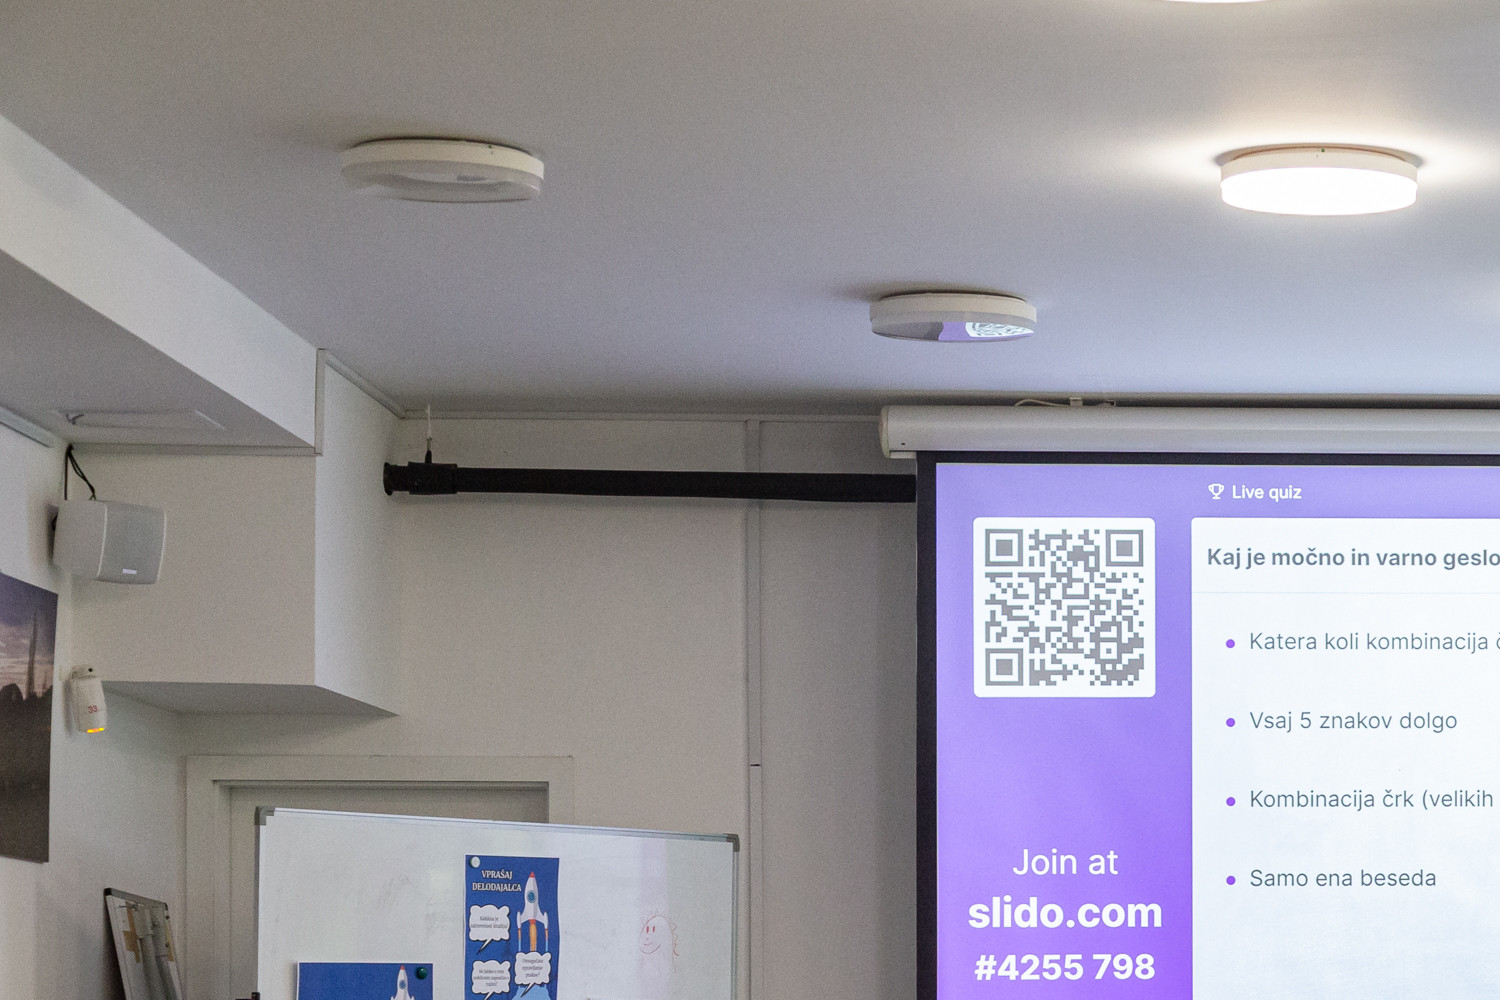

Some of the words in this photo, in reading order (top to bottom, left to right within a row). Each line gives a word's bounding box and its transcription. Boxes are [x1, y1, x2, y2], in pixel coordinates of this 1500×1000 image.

[1232, 484, 1265, 500] Live
[1268, 484, 1303, 503] quiz
[1207, 547, 1241, 570] Kaj
[1245, 547, 1266, 570] je
[1271, 546, 1345, 566] močno
[1351, 547, 1370, 566] in
[1376, 552, 1437, 566] varno
[1250, 632, 1317, 650] Katera
[1325, 631, 1359, 650] koli
[1366, 631, 1488, 655] kombinacija
[1249, 710, 1292, 734] Vsaj
[1300, 711, 1312, 729] 5
[1319, 711, 1393, 730] znakov
[1399, 711, 1458, 734] dolgo
[1250, 789, 1375, 812] Kombinacija
[1382, 788, 1415, 808] črk
[1421, 788, 1495, 811] (velikih
[1012, 848, 1077, 876] Join
[1088, 850, 1119, 875] at
[481, 869, 513, 880] VPRAŠAJ
[1250, 869, 1309, 887] Samo
[1315, 873, 1353, 887] ena
[1360, 869, 1436, 887] beseda
[471, 882, 522, 892] DELODAJALCA
[968, 894, 1162, 929] slido.com
[974, 953, 1084, 981] #4255
[1092, 953, 1156, 980] 798
